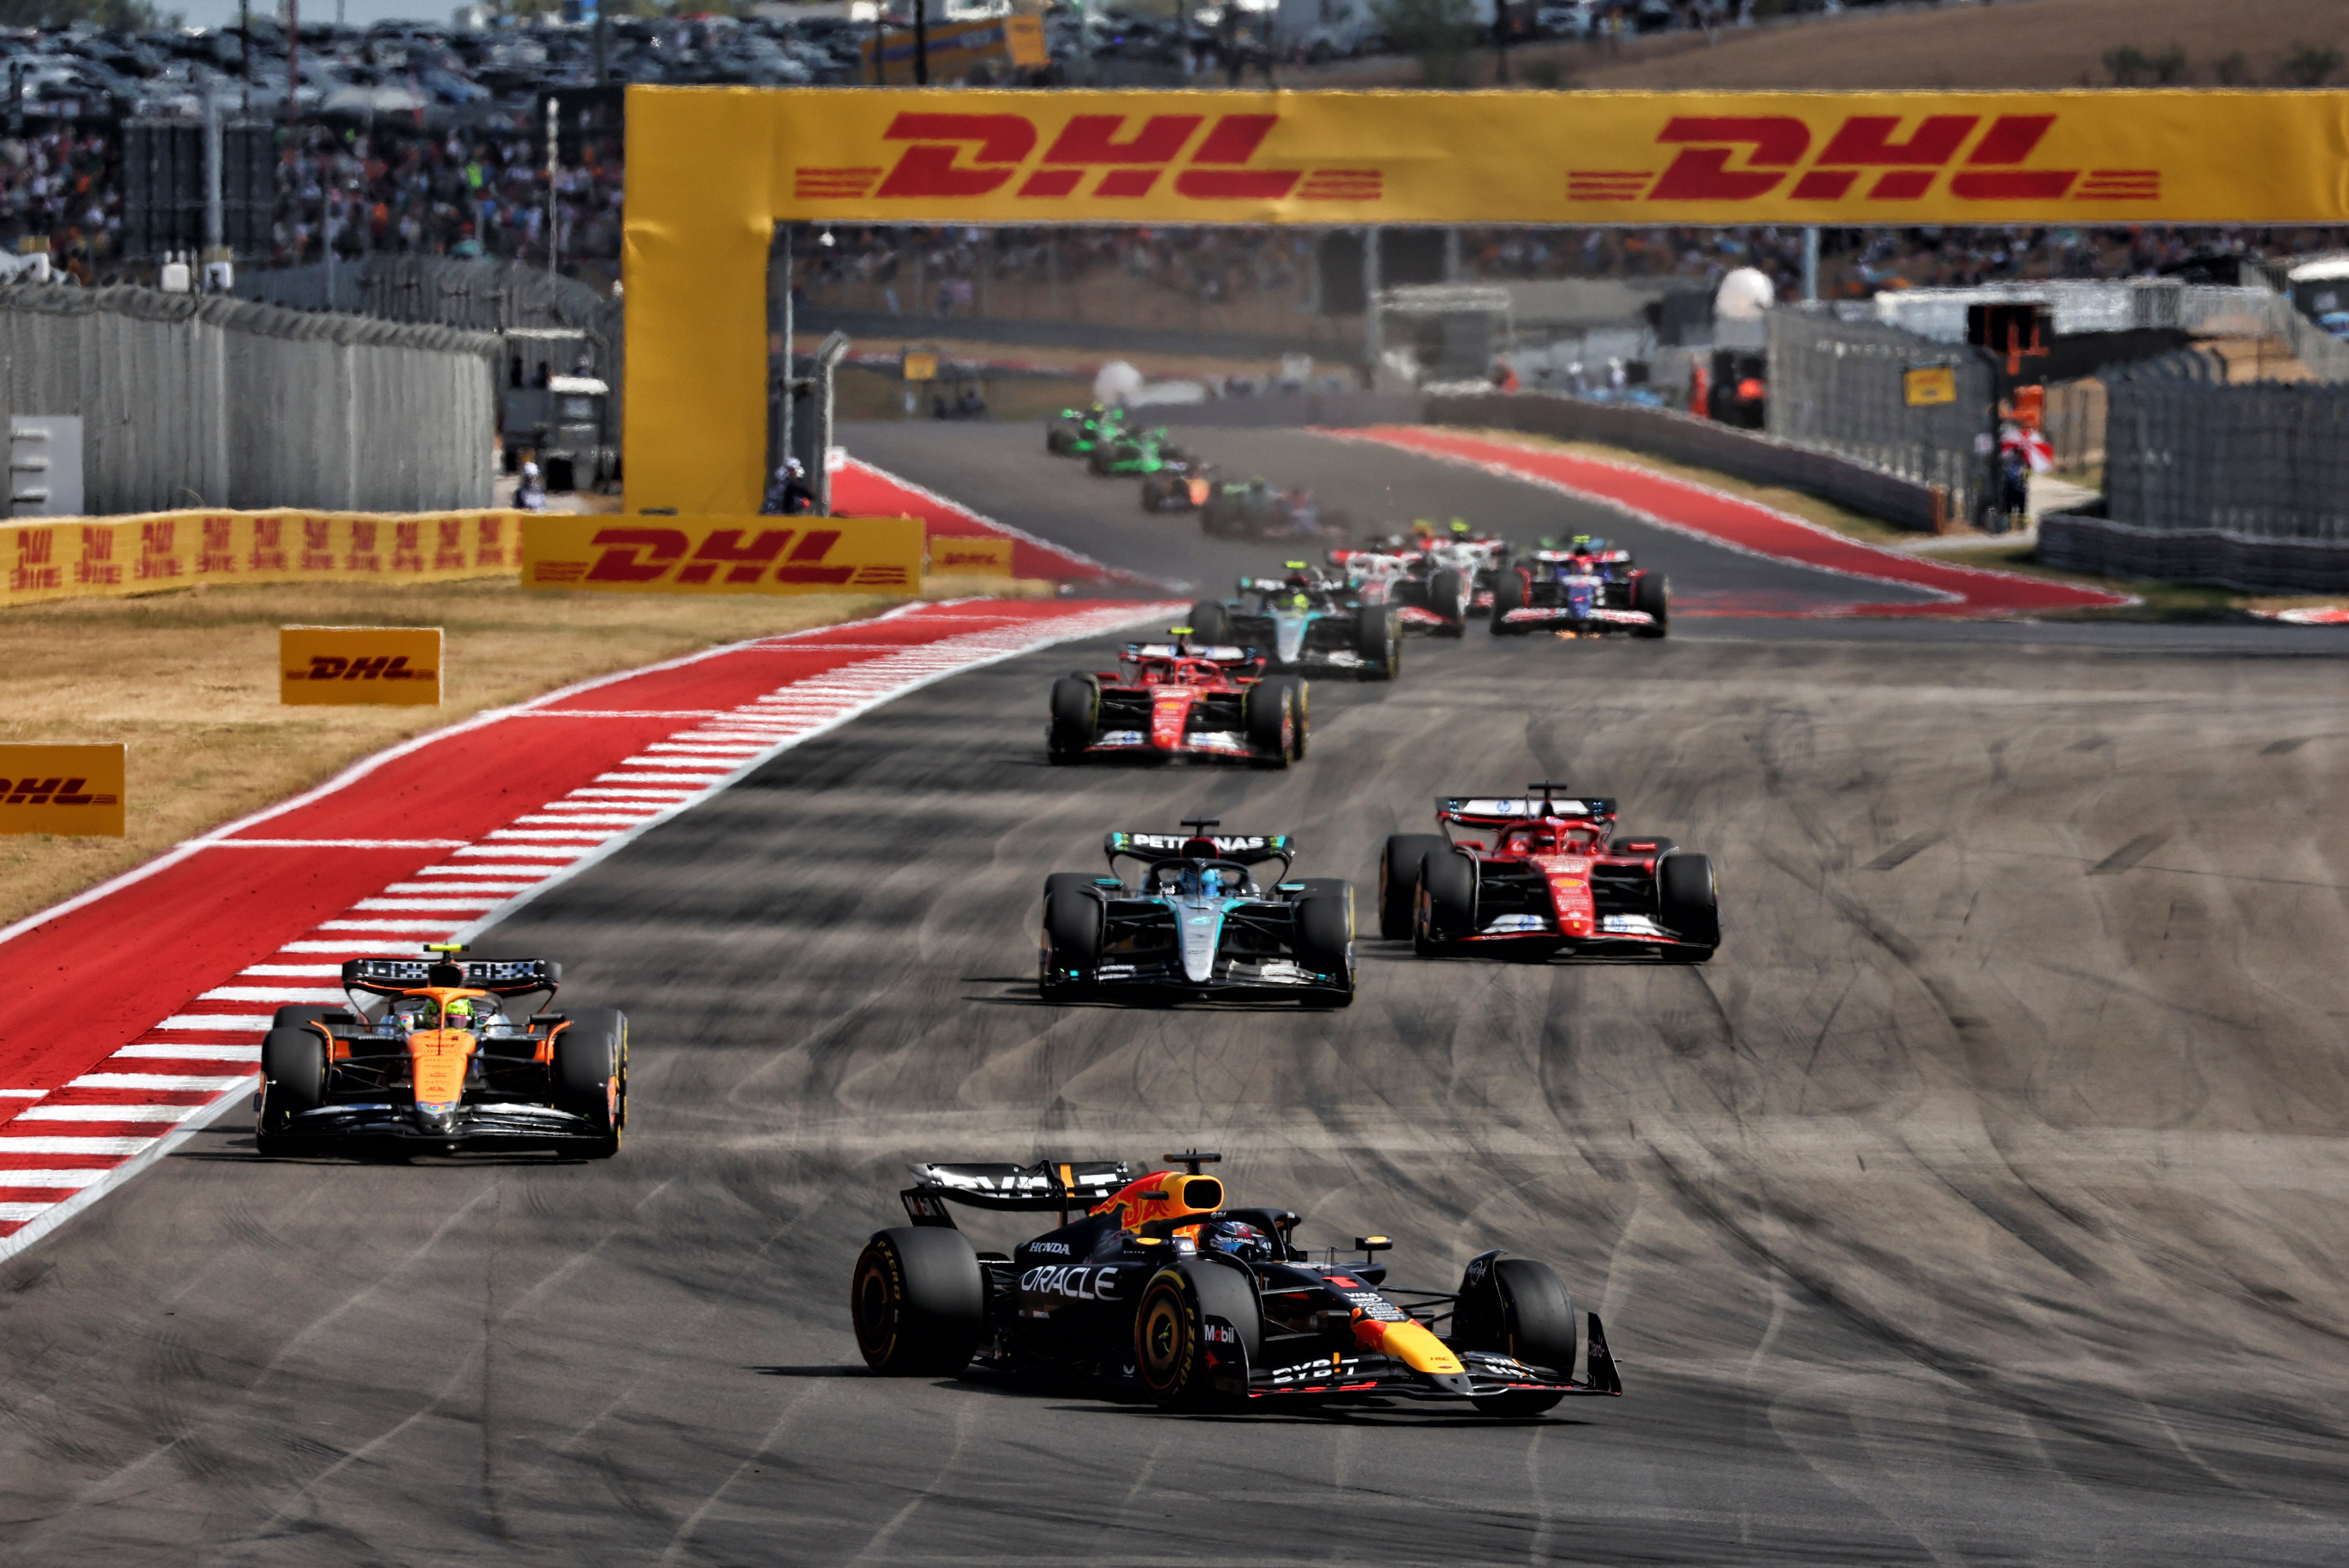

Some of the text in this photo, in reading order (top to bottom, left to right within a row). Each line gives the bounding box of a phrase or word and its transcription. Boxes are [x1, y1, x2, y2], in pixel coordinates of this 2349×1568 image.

[873, 111, 1304, 198] DHL
[1645, 114, 2081, 200] DHL
[583, 528, 857, 584] DHL
[309, 655, 413, 681] DHL
[0, 777, 94, 805] HL
[1133, 834, 1264, 851] PETNAS
[1021, 1265, 1124, 1301] ORACLE
[1204, 1324, 1235, 1343] Mobil
[1180, 1326, 1195, 1385] ZERO
